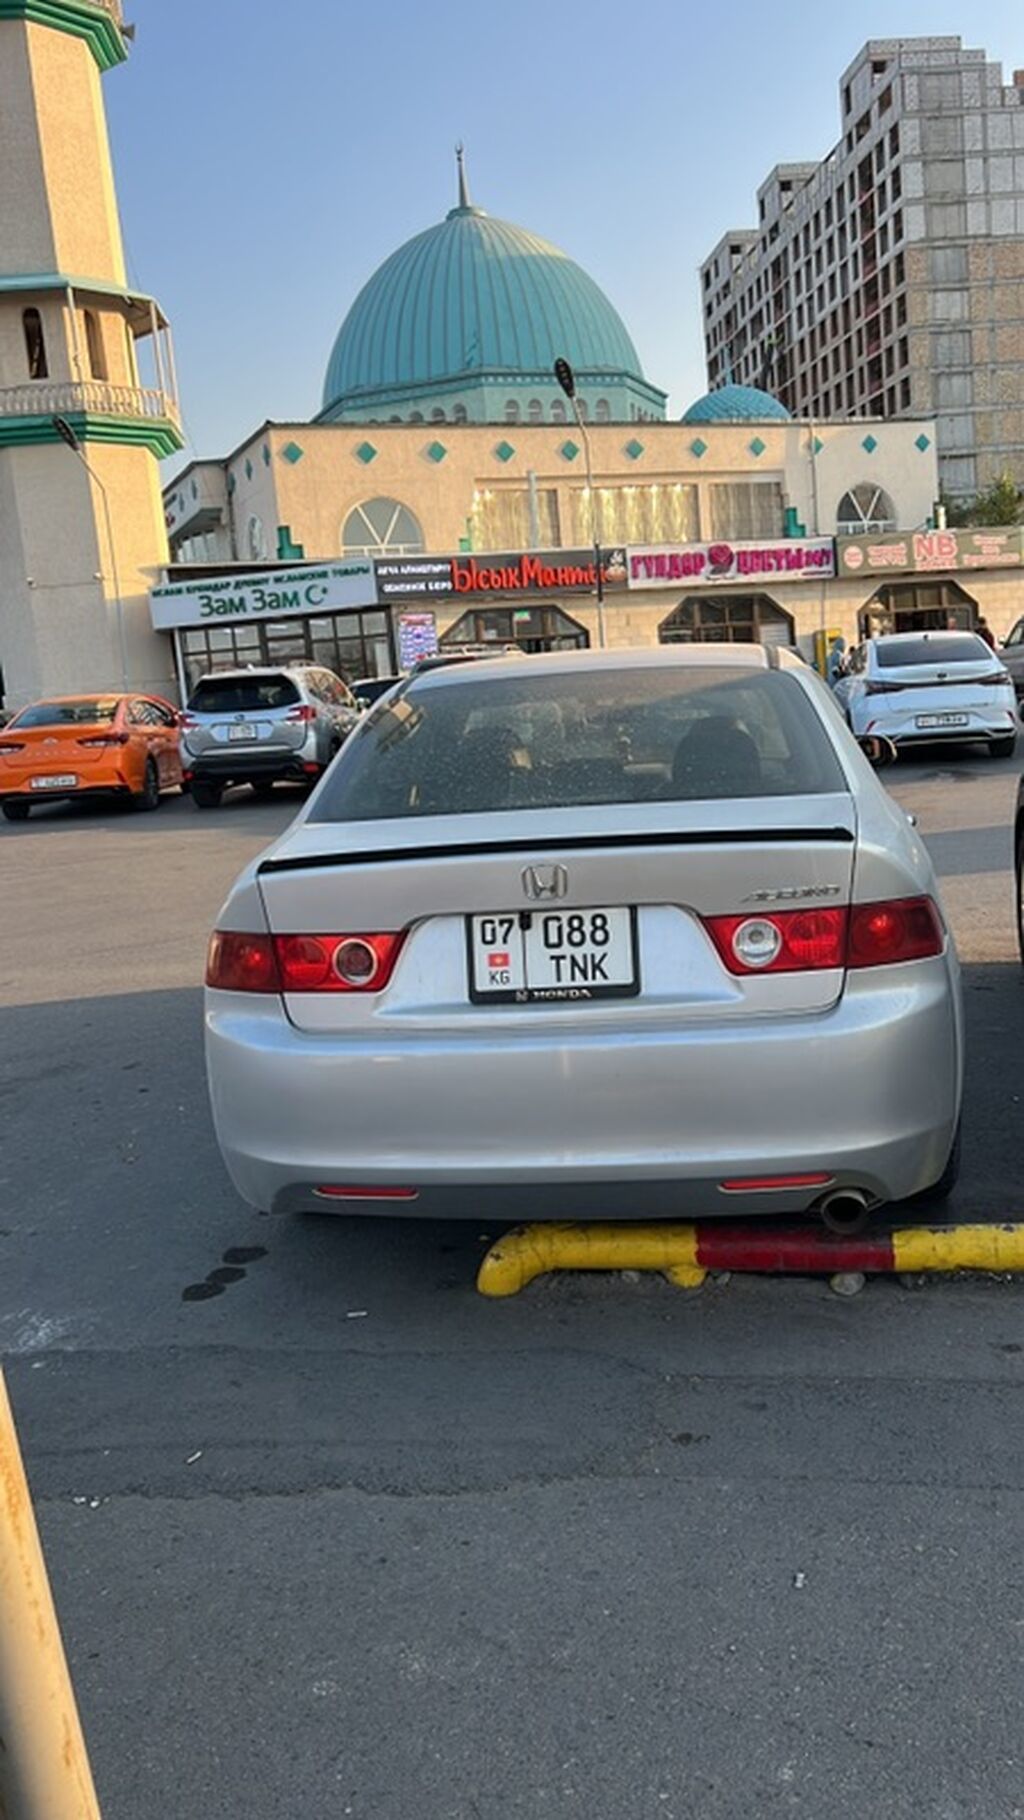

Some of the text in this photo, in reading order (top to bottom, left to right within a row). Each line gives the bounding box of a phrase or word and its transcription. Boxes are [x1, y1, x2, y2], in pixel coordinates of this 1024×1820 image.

[914, 534, 957, 559] NB
[451, 557, 520, 593] Ысык
[198, 588, 301, 618] Зам Зам
[481, 918, 514, 945] 07
[543, 913, 610, 949] 088
[489, 970, 510, 986] KG
[550, 952, 609, 983] TNK
